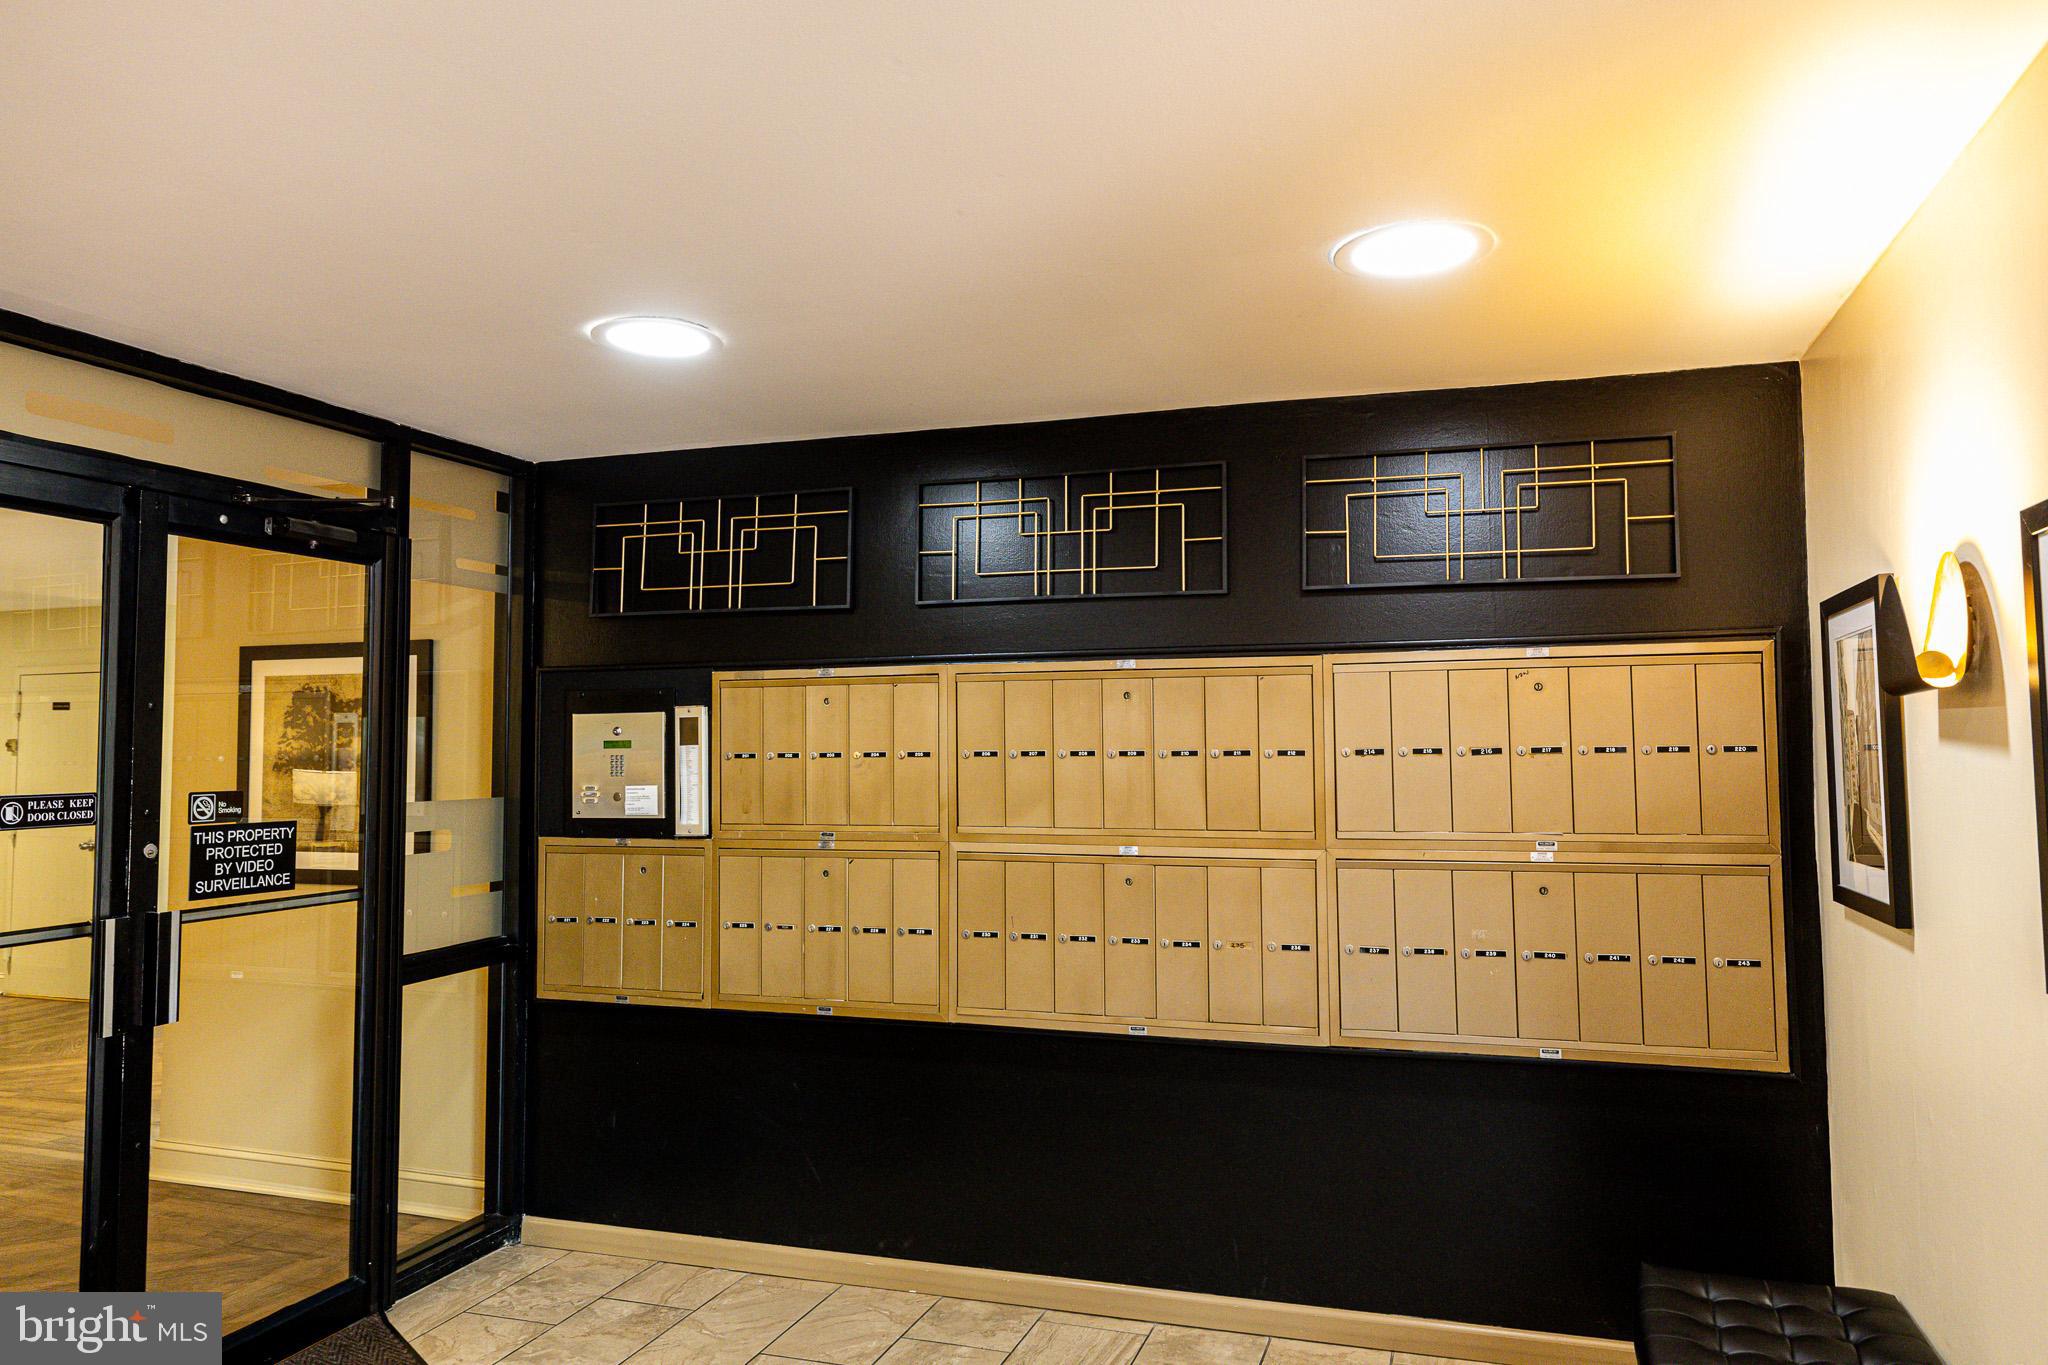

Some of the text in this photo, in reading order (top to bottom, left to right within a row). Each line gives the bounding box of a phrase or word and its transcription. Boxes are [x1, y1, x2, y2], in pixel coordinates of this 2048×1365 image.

[27, 798, 94, 810] PLEASE KEEP
[218, 806, 242, 814] Smoking
[27, 810, 94, 822] DOOR CLOSED
[194, 827, 295, 845] THIS PROPERTY
[206, 843, 283, 860] PROTECTED
[215, 859, 274, 876] BY VIDEO
[195, 873, 291, 894] SURVEILLANCE
